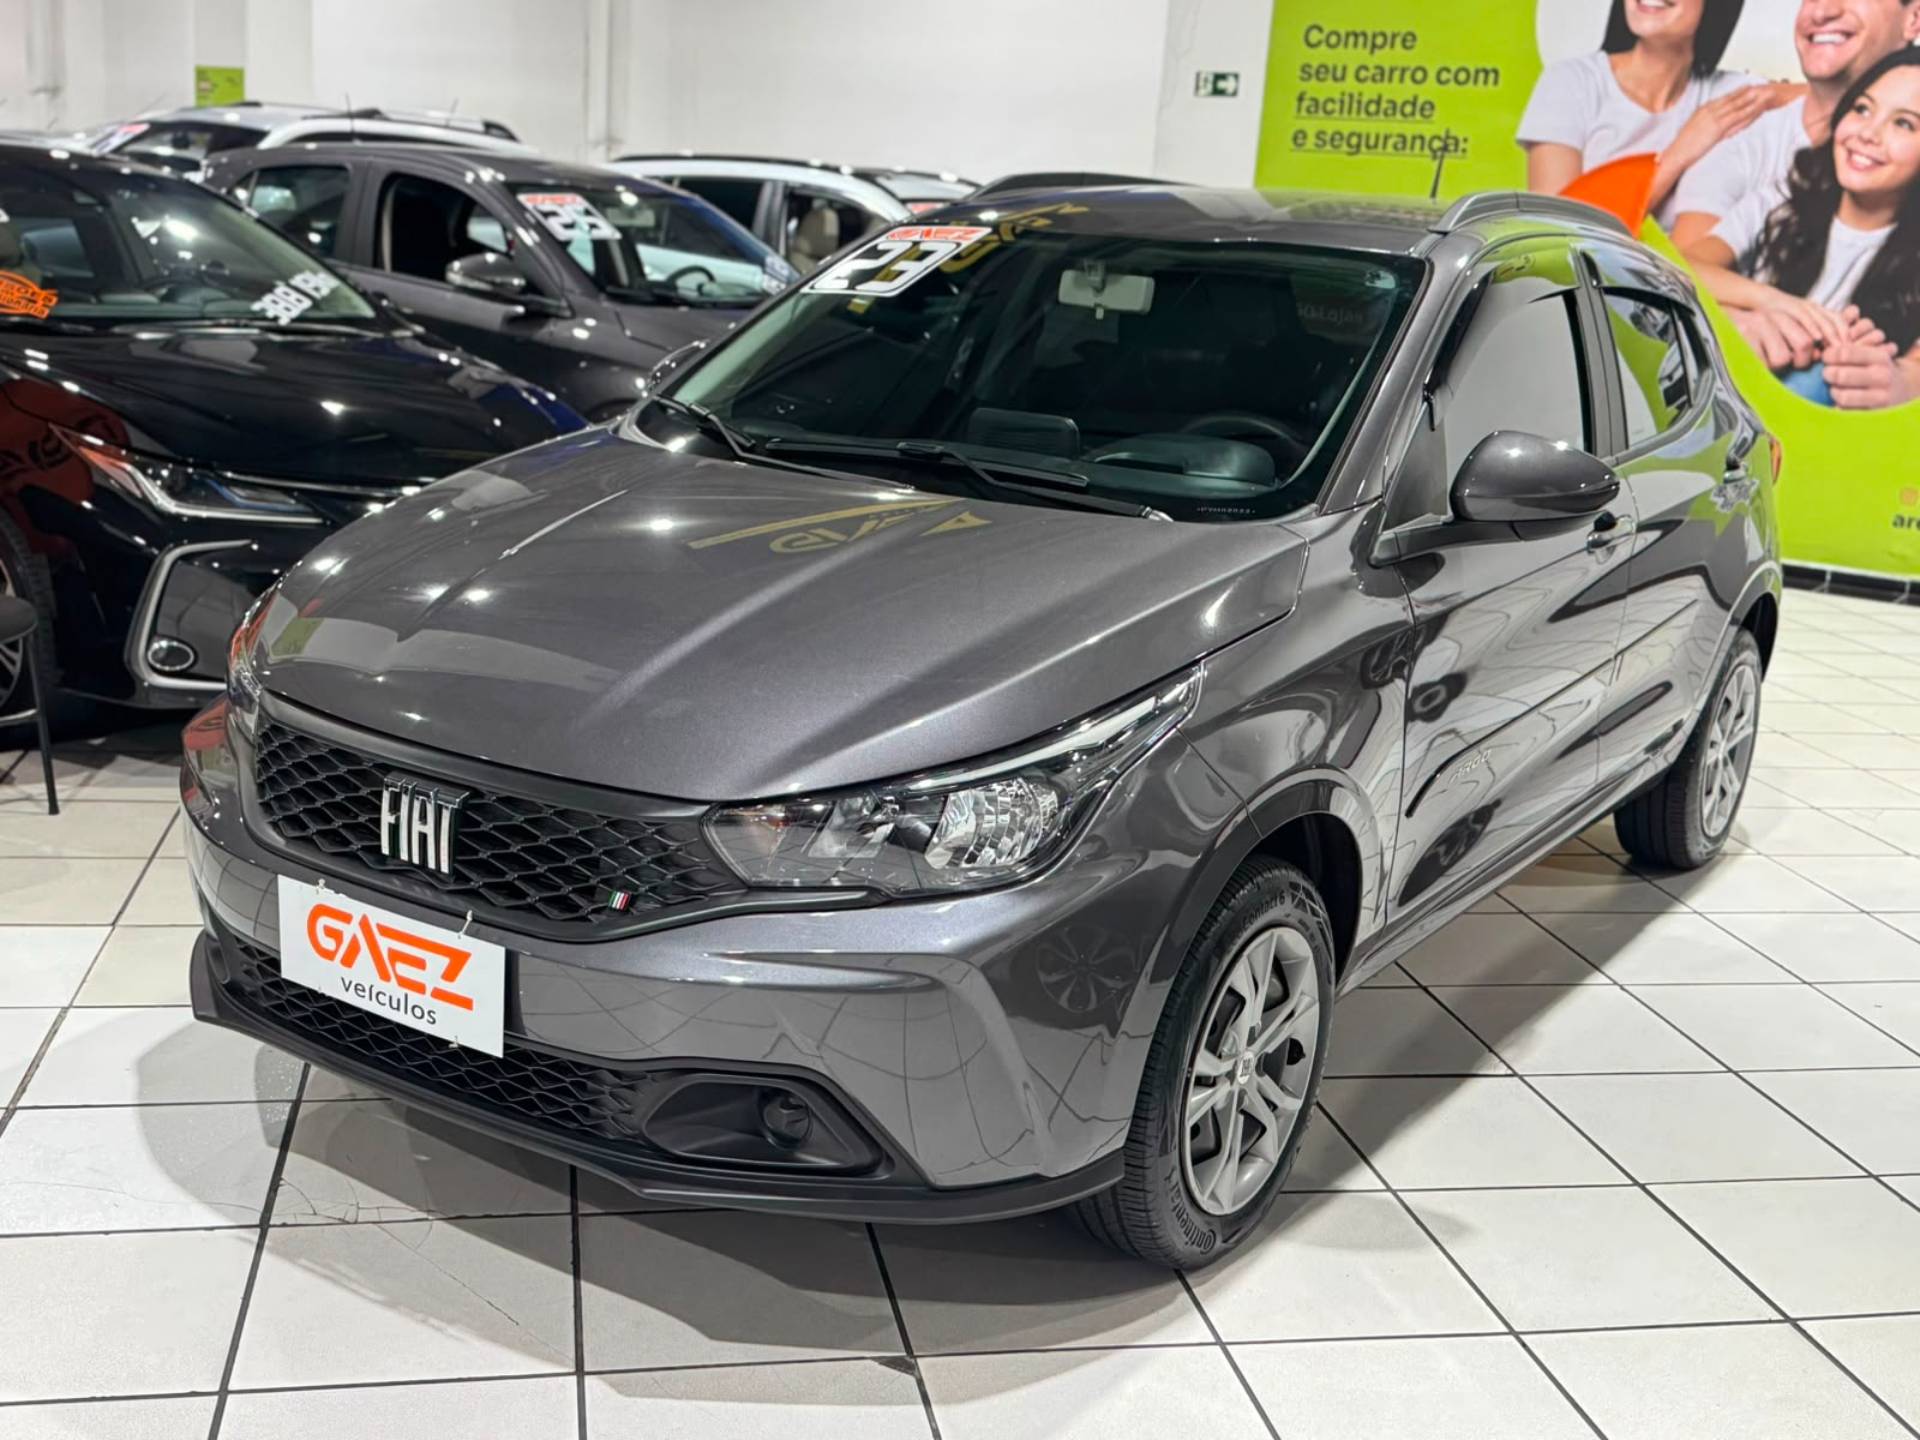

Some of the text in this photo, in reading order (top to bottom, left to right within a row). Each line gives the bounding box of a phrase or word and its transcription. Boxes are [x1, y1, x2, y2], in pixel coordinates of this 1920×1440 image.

[1303, 23, 1418, 55] Compre
[1299, 63, 1500, 86] seu carro com
[1295, 91, 1436, 119] facilidade
[1291, 128, 1468, 161] e segurança:
[812, 240, 961, 292] 23
[380, 778, 463, 875] FIAT
[306, 903, 474, 1011] GAEZ
[340, 976, 437, 1025] veículos
